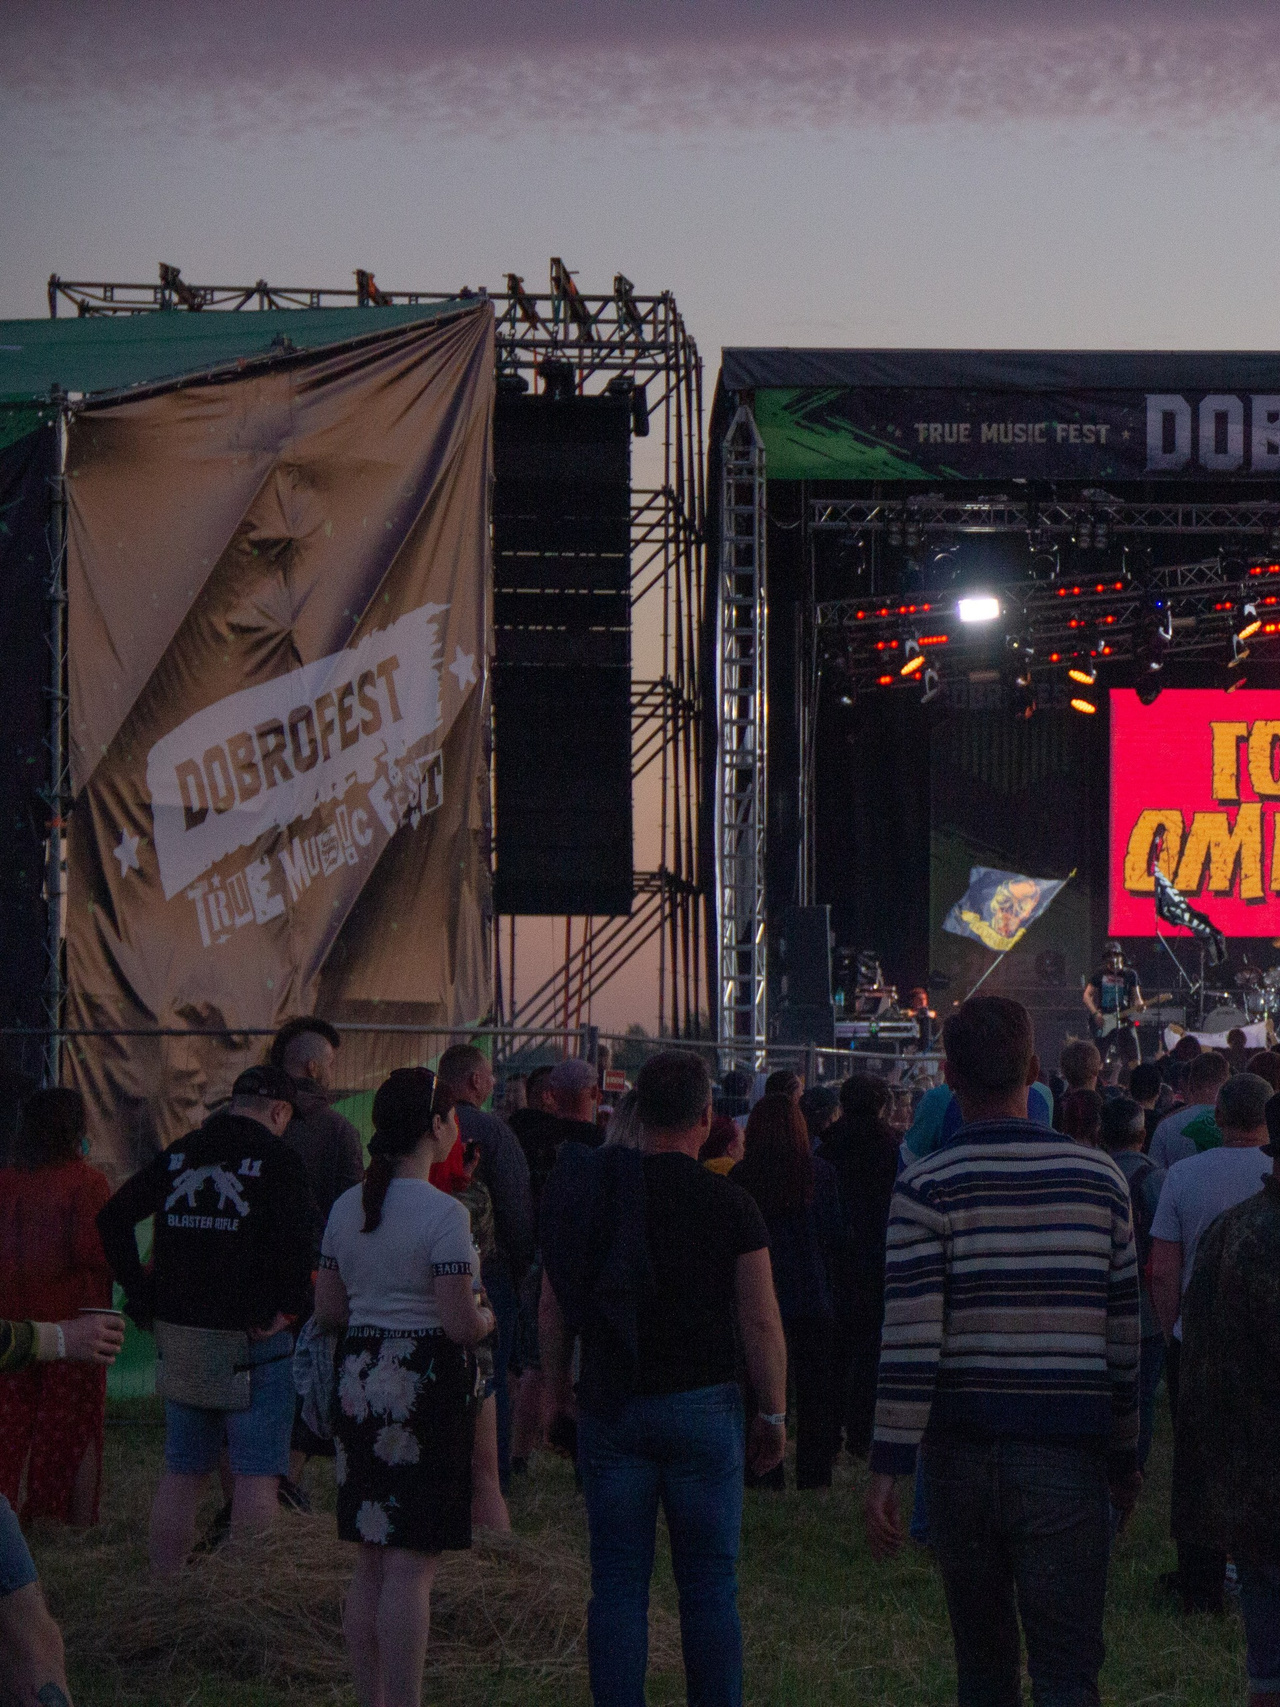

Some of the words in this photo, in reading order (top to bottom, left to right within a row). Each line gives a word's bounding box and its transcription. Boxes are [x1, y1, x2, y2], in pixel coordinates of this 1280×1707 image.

[914, 421, 971, 444] TRUE
[980, 420, 1047, 444] MUSIC
[1056, 423, 1110, 444] FEST
[174, 654, 403, 832] DOBROFEST
[167, 1213, 213, 1229] BLASTER
[214, 1217, 239, 1231] RIFLE
